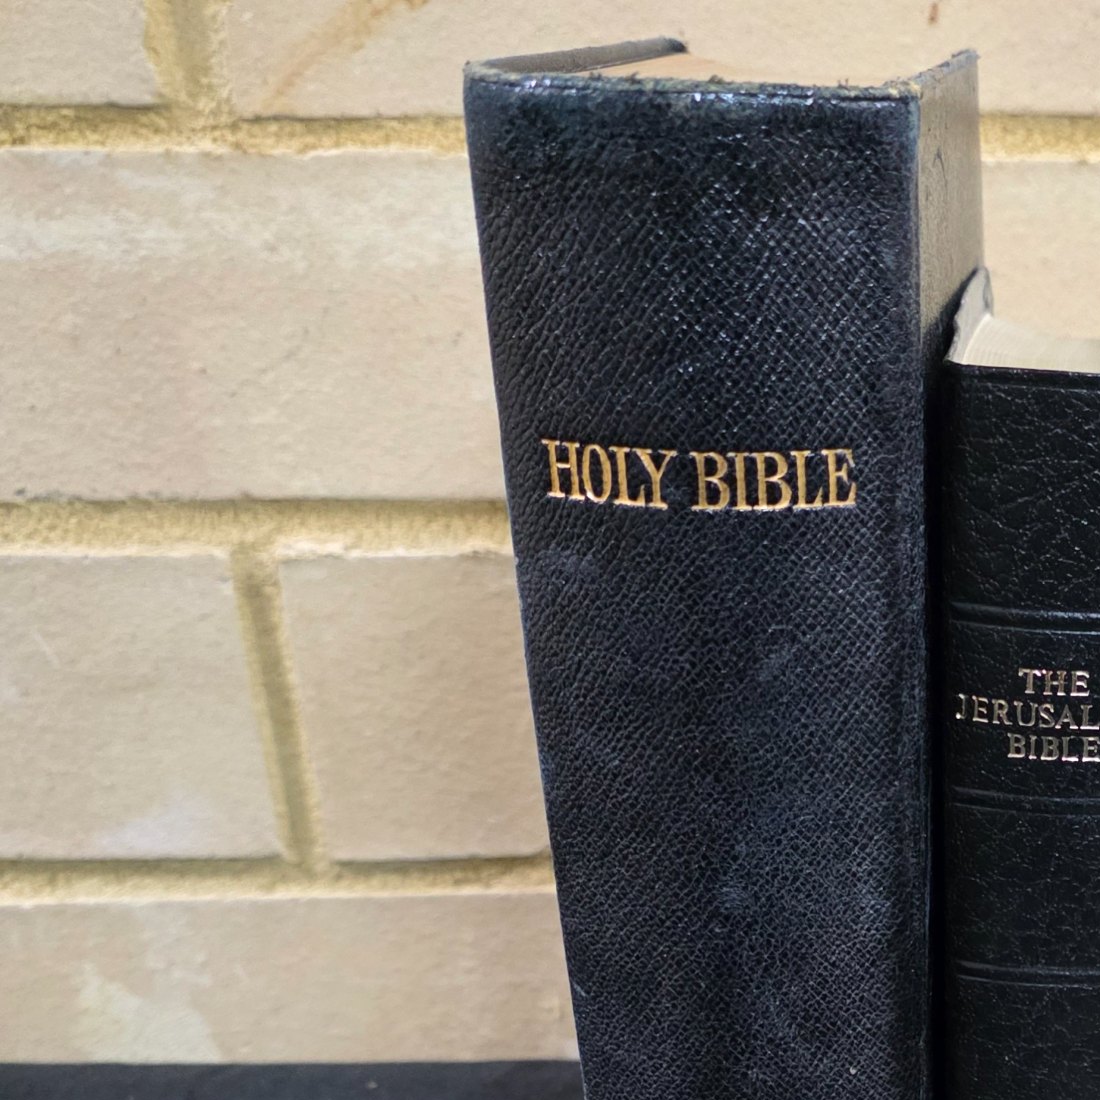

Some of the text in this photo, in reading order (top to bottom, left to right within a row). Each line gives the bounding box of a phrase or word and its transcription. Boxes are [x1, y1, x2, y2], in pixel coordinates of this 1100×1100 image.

[541, 438, 857, 512] HOLY BIBLE
[1018, 667, 1091, 697] THE
